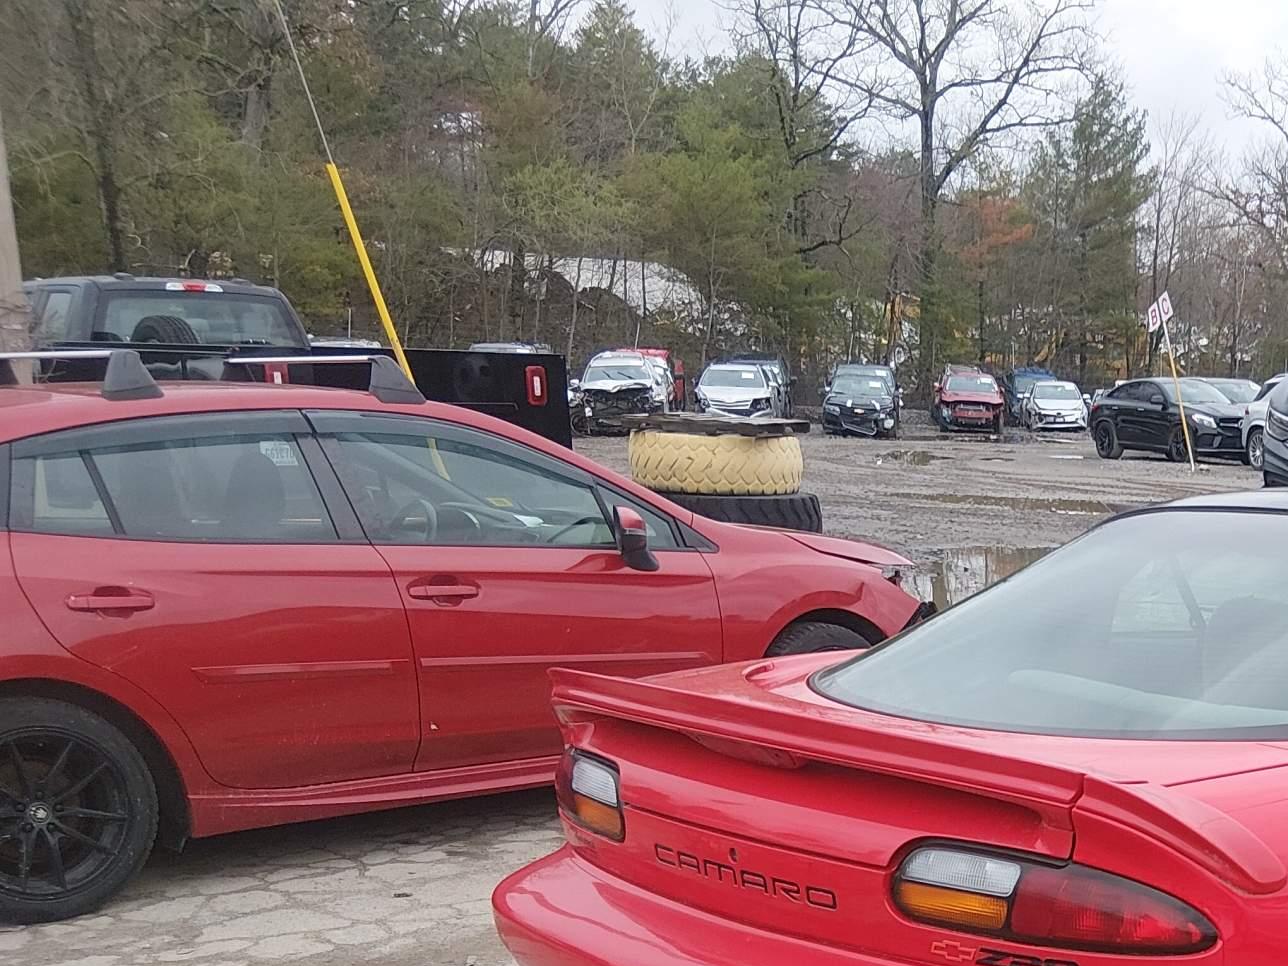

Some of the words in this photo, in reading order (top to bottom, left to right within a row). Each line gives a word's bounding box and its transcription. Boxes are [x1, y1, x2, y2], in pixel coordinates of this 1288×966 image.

[1162, 297, 1170, 315] C
[1151, 308, 1158, 326] B
[655, 843, 838, 912] CAMARO
